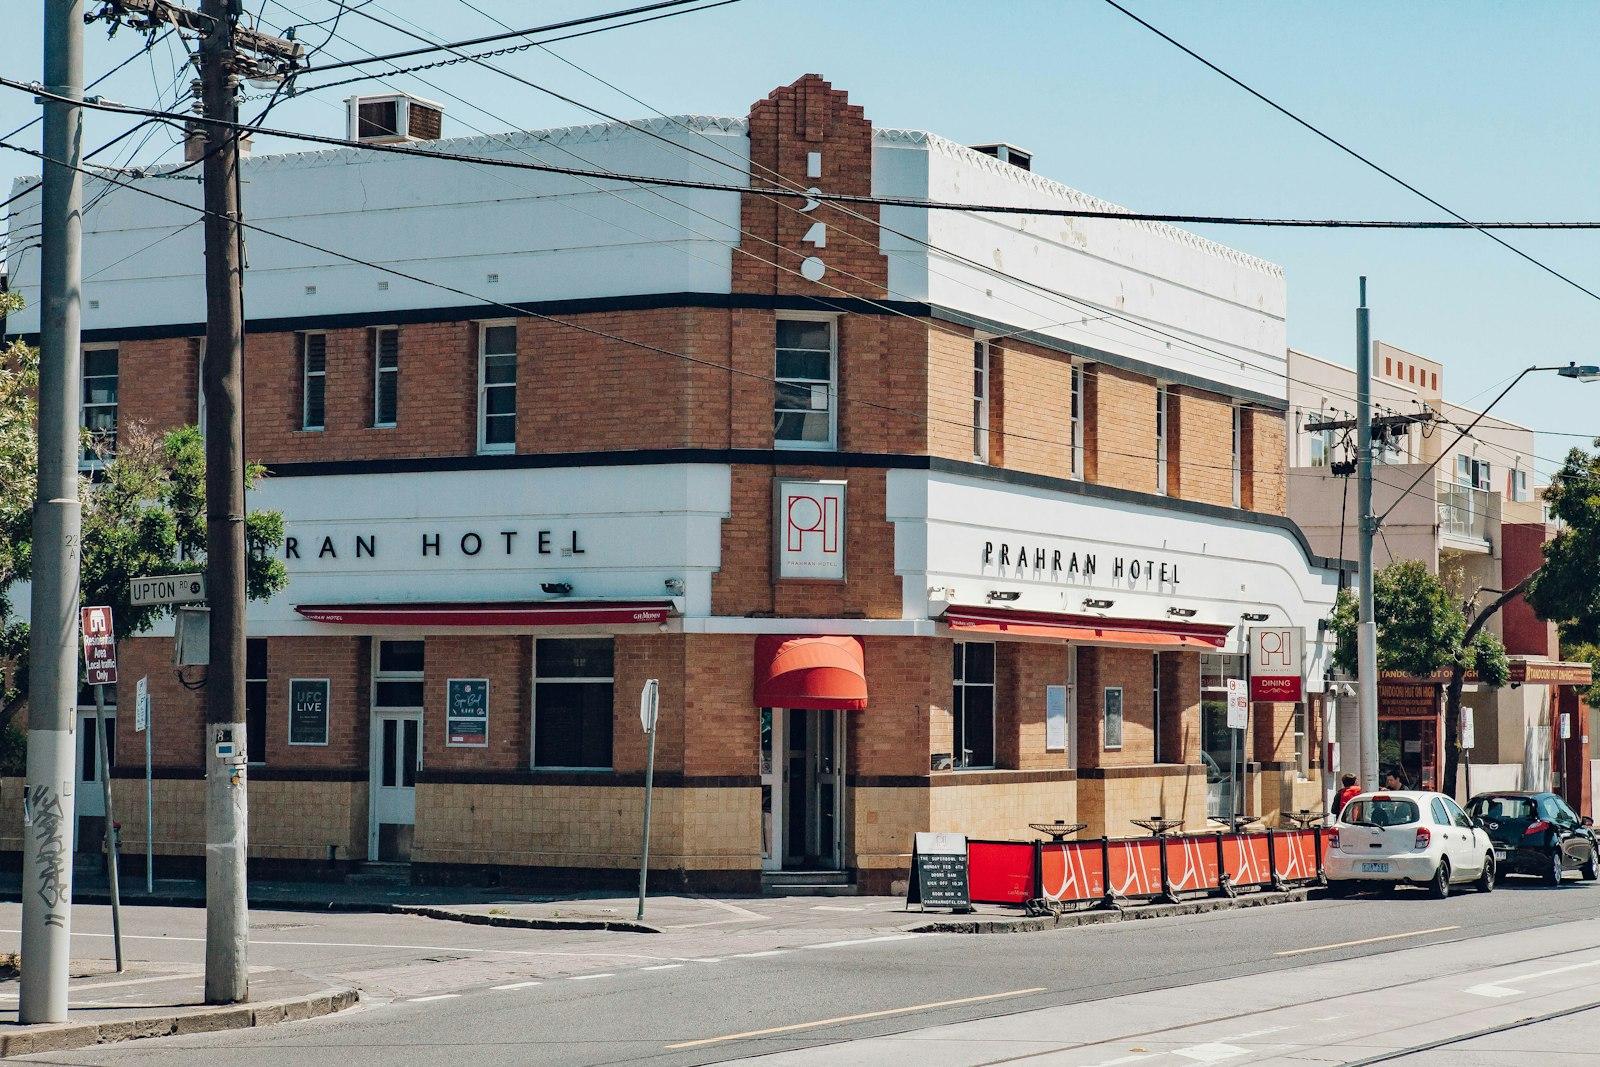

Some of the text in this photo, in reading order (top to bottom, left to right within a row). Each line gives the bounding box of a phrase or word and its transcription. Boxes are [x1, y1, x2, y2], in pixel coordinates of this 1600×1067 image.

[422, 530, 585, 556] HOTEL
[985, 541, 1180, 584] PRAHRAN HOTEL
[133, 580, 188, 600] UPTON RD
[94, 648, 107, 658] Area
[88, 660, 101, 670] Local
[96, 671, 109, 681] Only
[1262, 679, 1291, 687] DINING
[297, 691, 322, 702] UFC
[297, 702, 322, 712] LIVE
